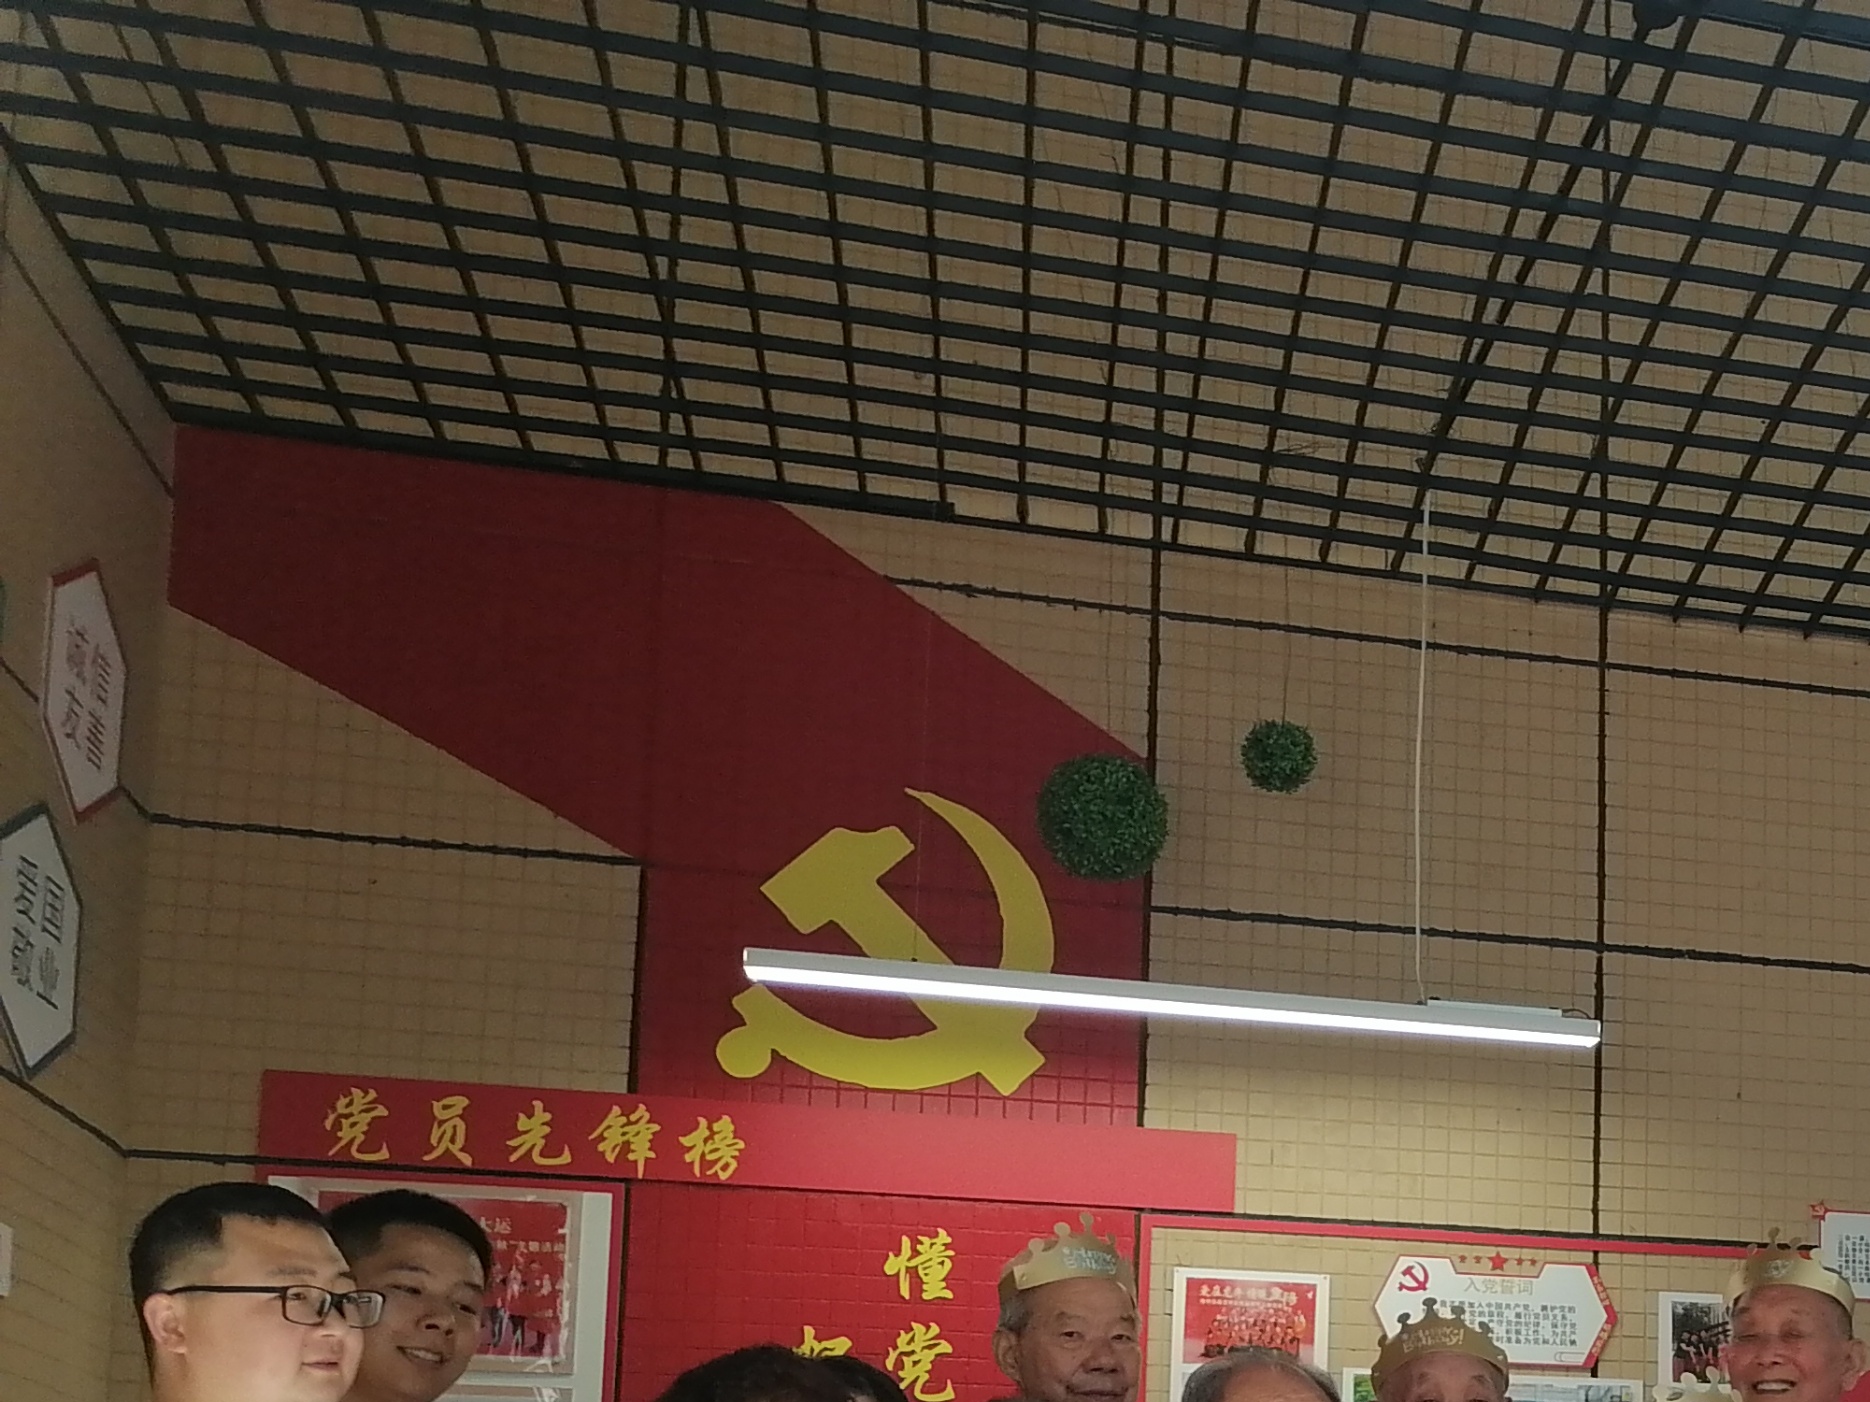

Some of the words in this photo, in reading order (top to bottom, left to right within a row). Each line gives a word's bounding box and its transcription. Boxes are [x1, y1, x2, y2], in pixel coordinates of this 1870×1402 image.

[322, 1086, 750, 1181] 党员先锋榜
[1463, 1277, 1535, 1297] 入党誓词
